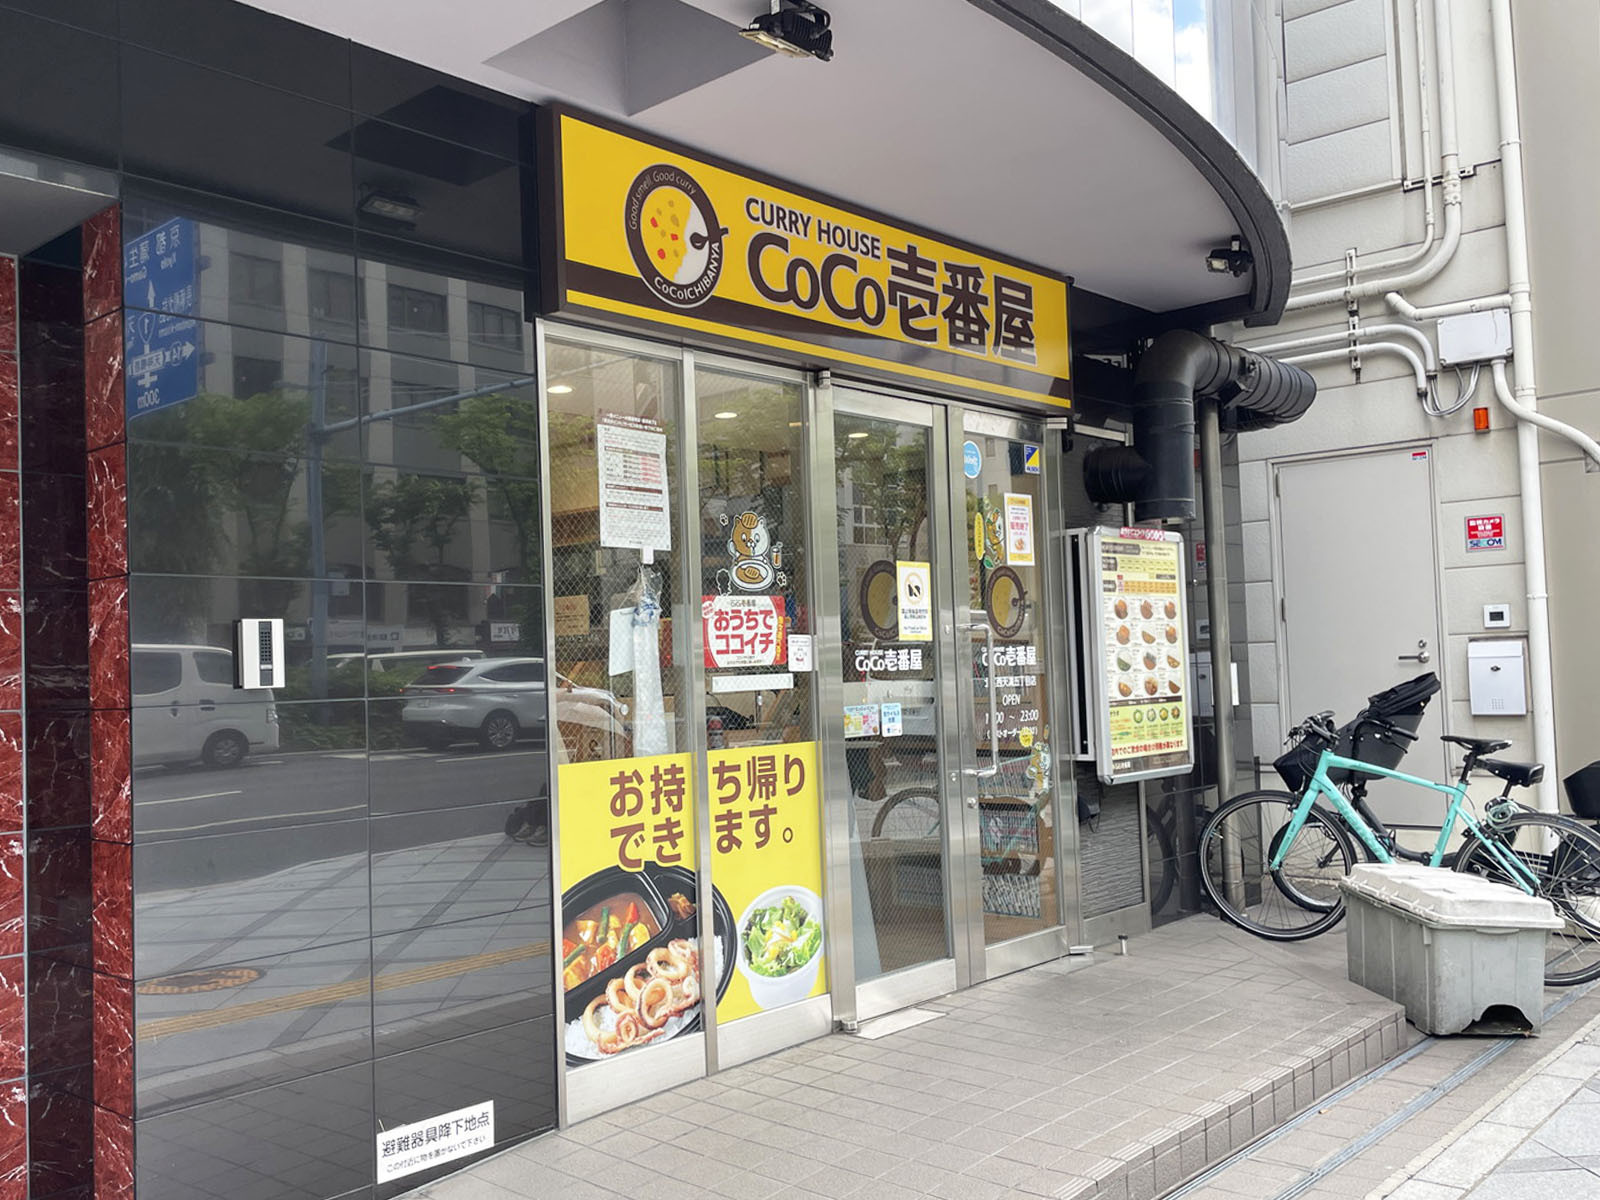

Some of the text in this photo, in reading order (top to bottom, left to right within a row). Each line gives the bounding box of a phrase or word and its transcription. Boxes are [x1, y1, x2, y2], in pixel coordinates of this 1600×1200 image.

[629, 196, 640, 230] Good
[653, 171, 675, 181] Good
[675, 175, 696, 195] curry
[745, 197, 882, 260] CURRY HOUSE
[654, 242, 720, 300] CoCoICHIBANYA
[746, 231, 1038, 367] CoCo壱番屋
[1469, 538, 1502, 548] SECOM
[714, 608, 774, 632] おうちで
[716, 632, 774, 655] ココイチ
[855, 649, 923, 671] CoCo壱番屋
[1002, 694, 1021, 706] OPEN
[1020, 710, 1039, 721] 23:00
[609, 754, 806, 818] お持ち帰り
[610, 804, 794, 868] できます。
[382, 1111, 490, 1158] 避難器具降下地点
[386, 1135, 486, 1173] この付近に物を置かないで下さい
